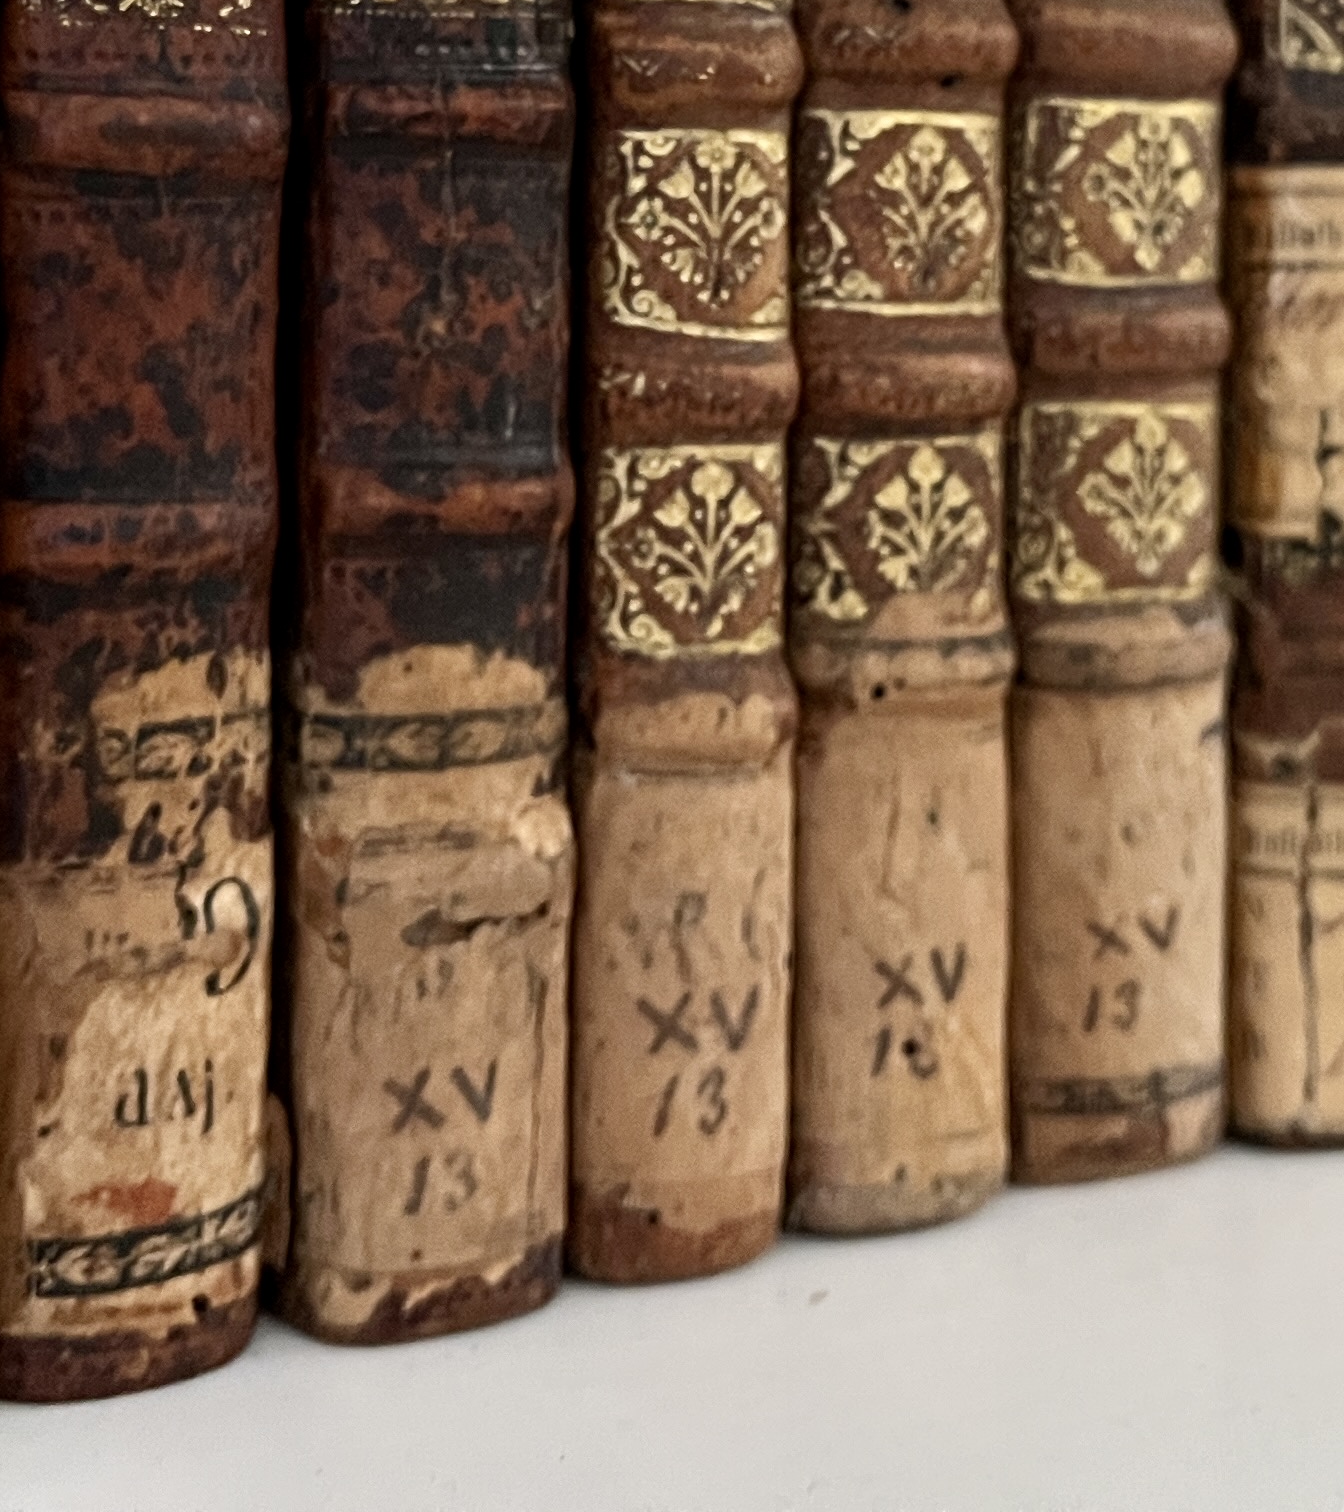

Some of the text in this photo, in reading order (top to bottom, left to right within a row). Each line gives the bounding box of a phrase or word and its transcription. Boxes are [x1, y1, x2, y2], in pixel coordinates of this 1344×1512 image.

[1086, 905, 1180, 959] XV
[874, 942, 967, 1008] XV
[636, 984, 759, 1055] XV
[384, 1059, 498, 1134] XV
[654, 1066, 728, 1137] 13
